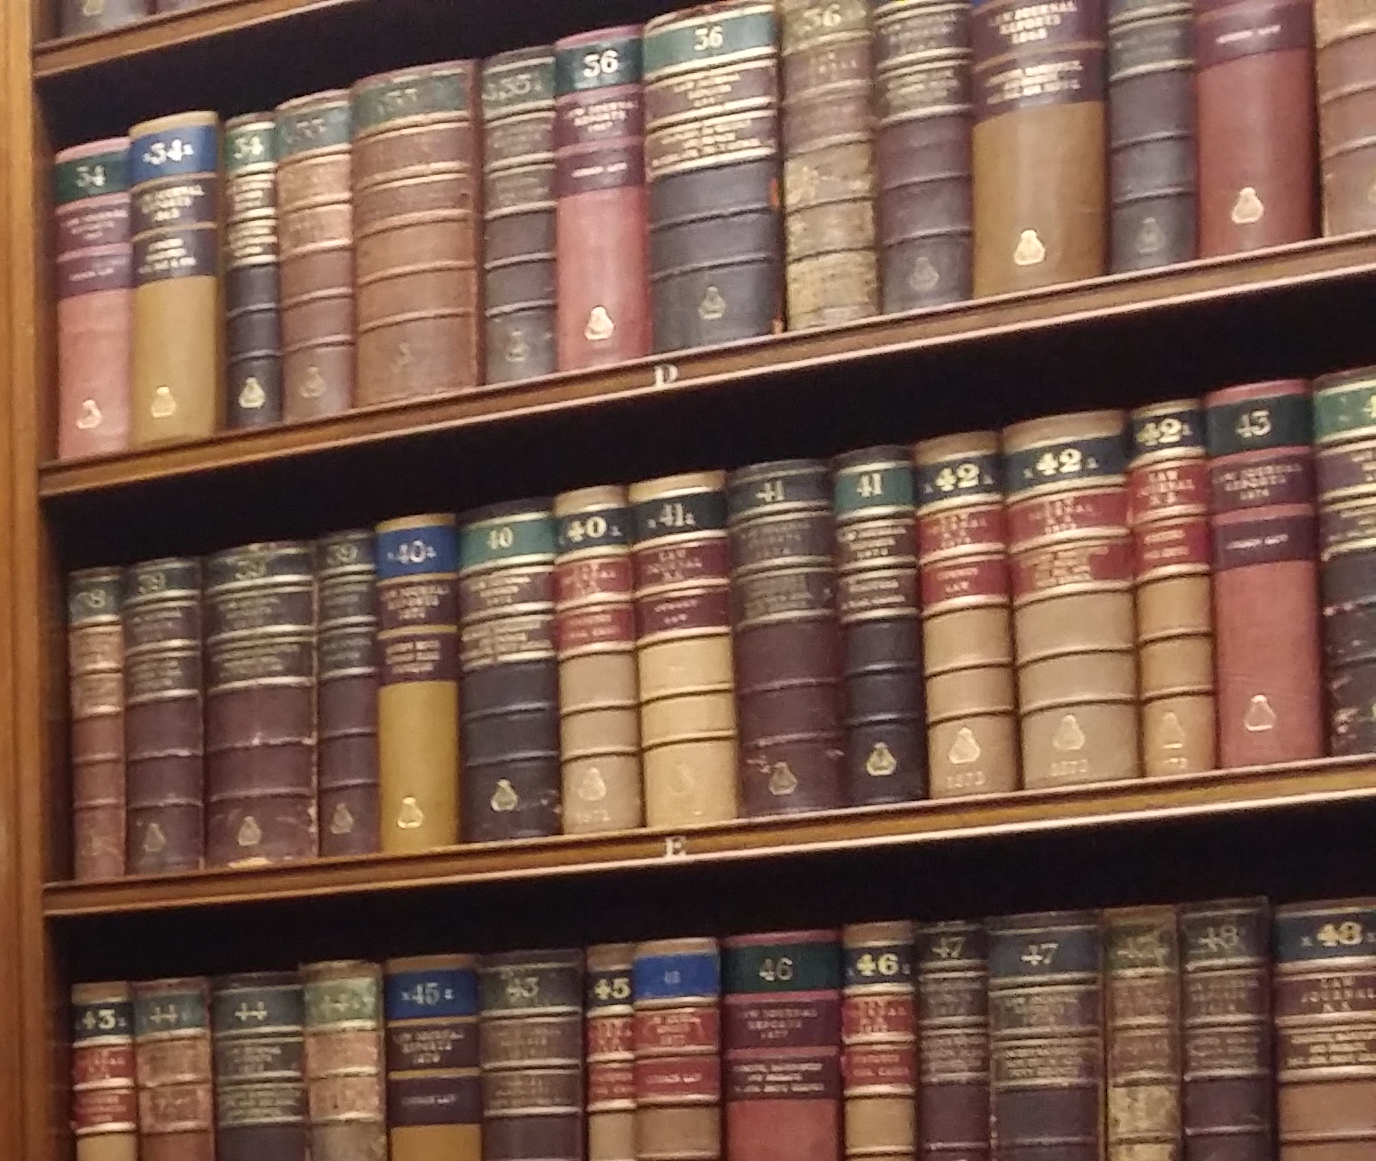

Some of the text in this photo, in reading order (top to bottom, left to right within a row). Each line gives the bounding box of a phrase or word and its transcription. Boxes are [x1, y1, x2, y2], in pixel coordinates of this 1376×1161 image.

[1035, 447, 1084, 476] 42
[856, 472, 885, 499] 41
[934, 462, 981, 491] 42
[758, 956, 794, 983] 46
[856, 953, 899, 977] 46
